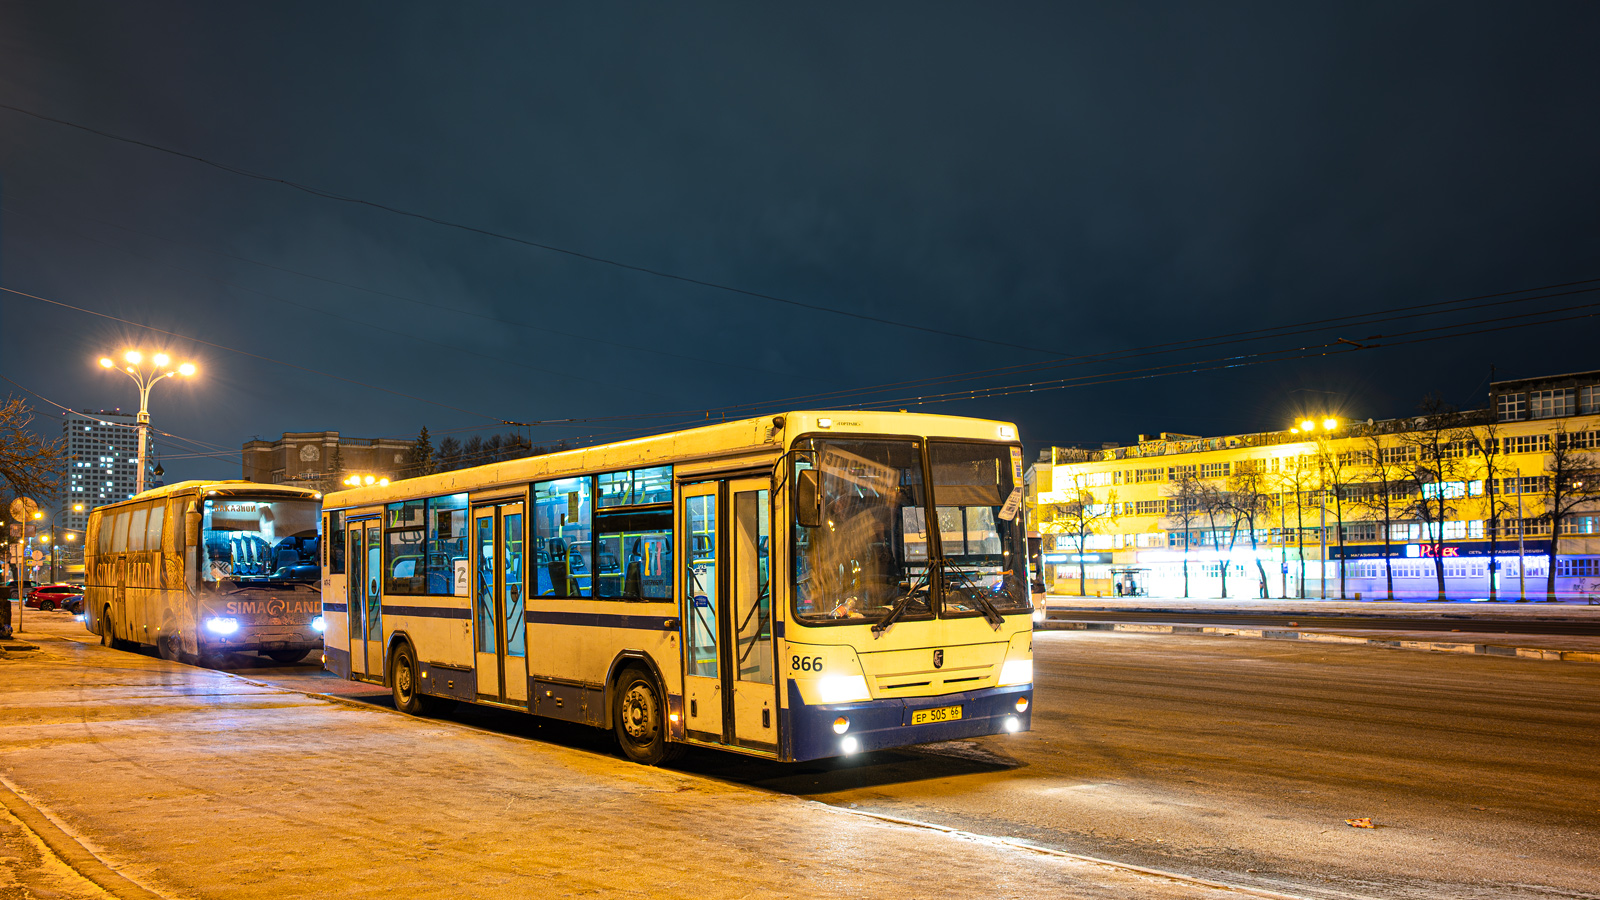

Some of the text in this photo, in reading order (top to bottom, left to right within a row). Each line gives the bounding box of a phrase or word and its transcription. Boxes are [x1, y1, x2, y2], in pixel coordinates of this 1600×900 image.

[226, 601, 322, 615] SIMA LAND
[792, 655, 823, 672] 866
[930, 709, 947, 721] 505
[950, 706, 959, 716] 66
